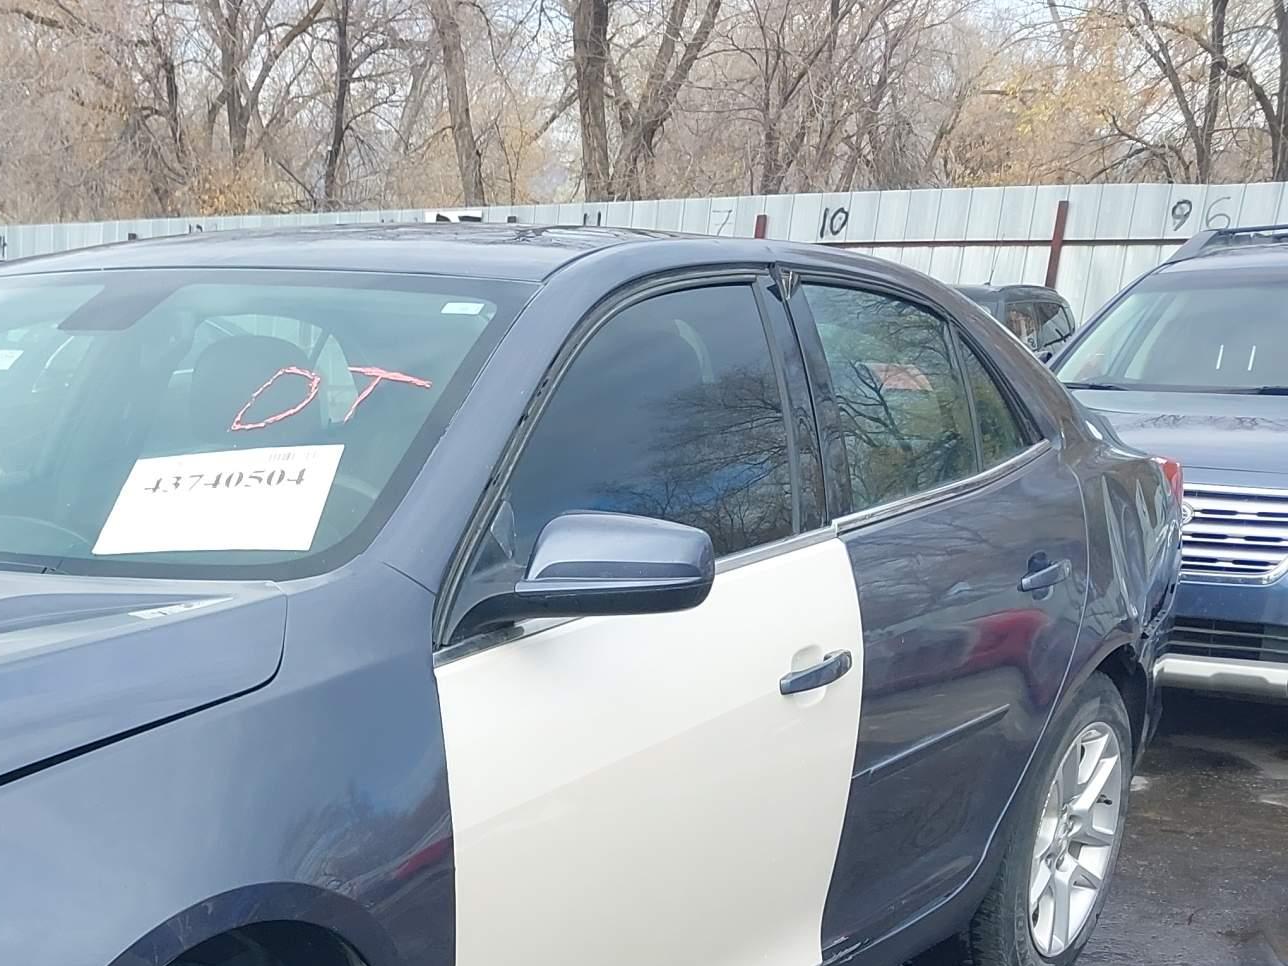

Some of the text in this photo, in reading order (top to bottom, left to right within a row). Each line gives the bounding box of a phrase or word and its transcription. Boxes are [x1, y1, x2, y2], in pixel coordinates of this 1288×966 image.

[819, 207, 850, 238] 10
[1171, 198, 1193, 232] 9
[1205, 196, 1232, 230] 6
